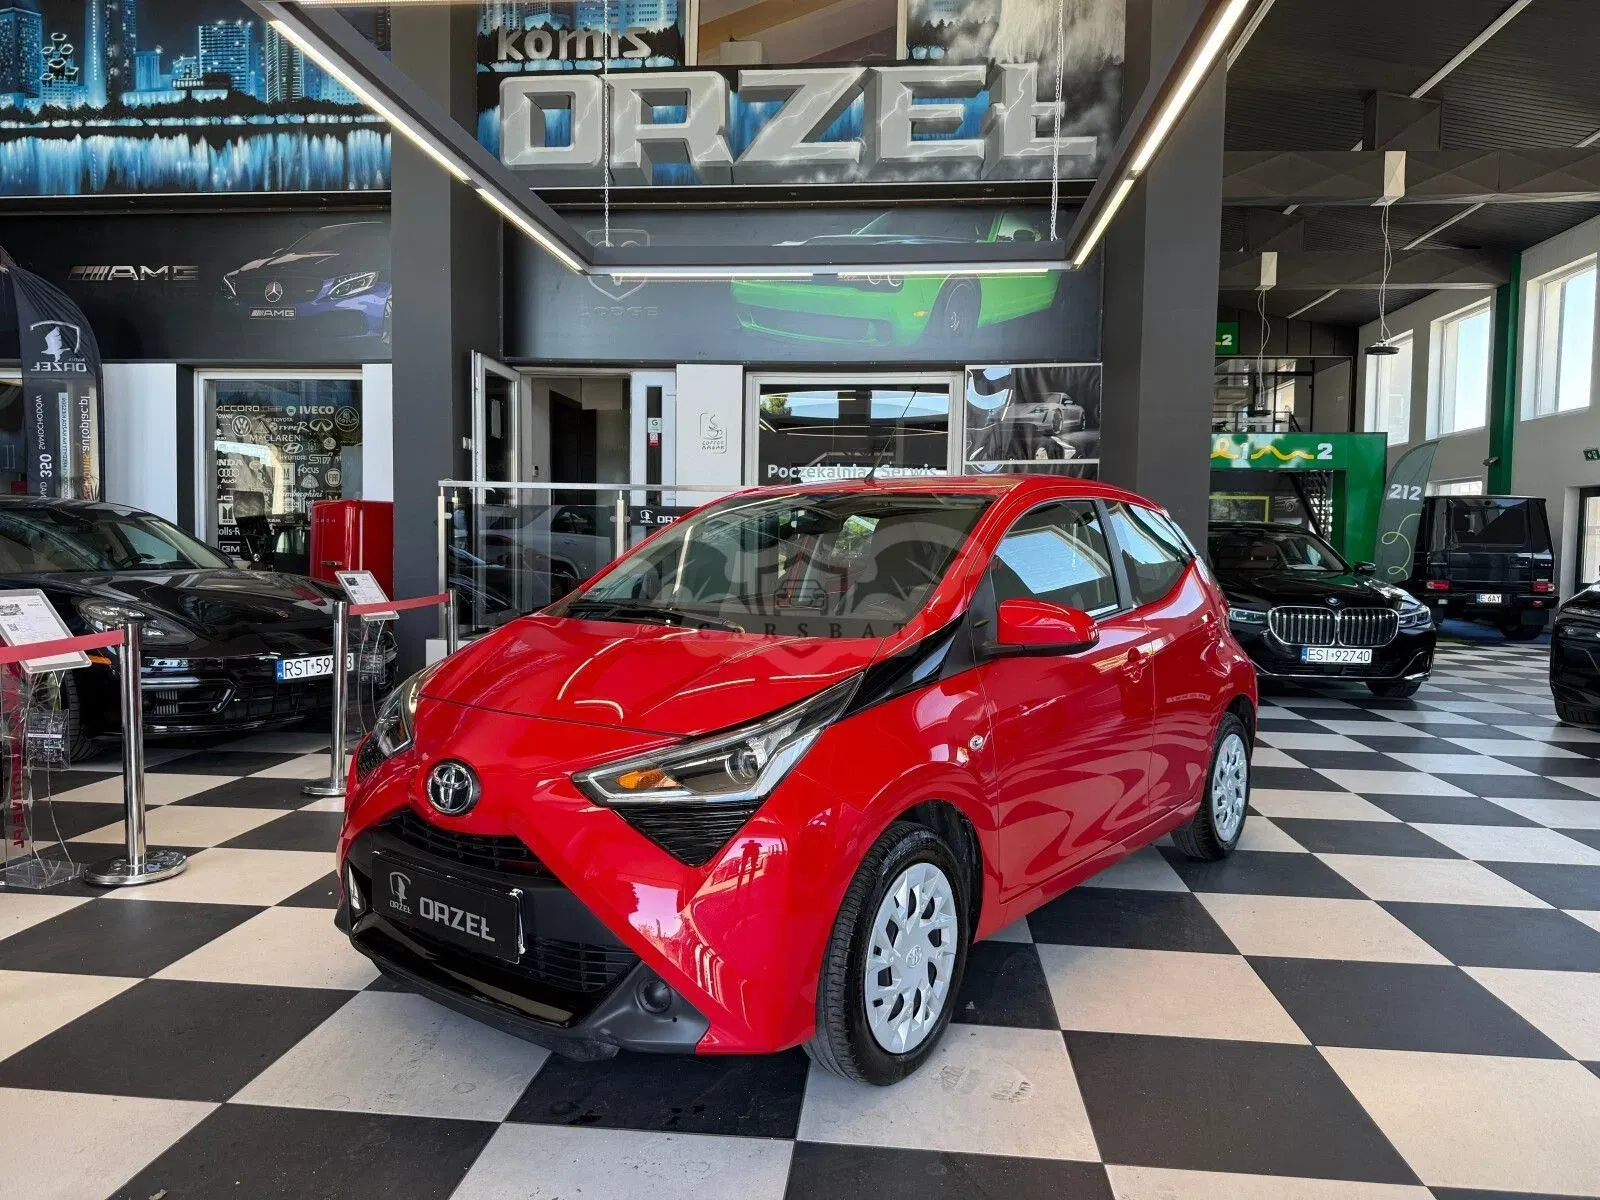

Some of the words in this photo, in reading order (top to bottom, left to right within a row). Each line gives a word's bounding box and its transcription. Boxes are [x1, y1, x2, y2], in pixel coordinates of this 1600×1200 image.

[497, 25, 652, 61] komis
[499, 63, 1098, 180] ORZEŁ
[107, 265, 200, 281] AMG
[263, 309, 295, 317] AMG
[300, 405, 335, 415] IVECO
[1317, 442, 1333, 460] 2
[767, 463, 867, 479] Poczekalnia
[880, 463, 938, 478] Serwis
[1388, 483, 1422, 501] 212
[1335, 650, 1371, 662] 92740
[284, 659, 311, 678] RST
[315, 655, 353, 674] 593
[389, 899, 413, 915] ORZEŁ
[419, 896, 496, 942] ORZEŁ
